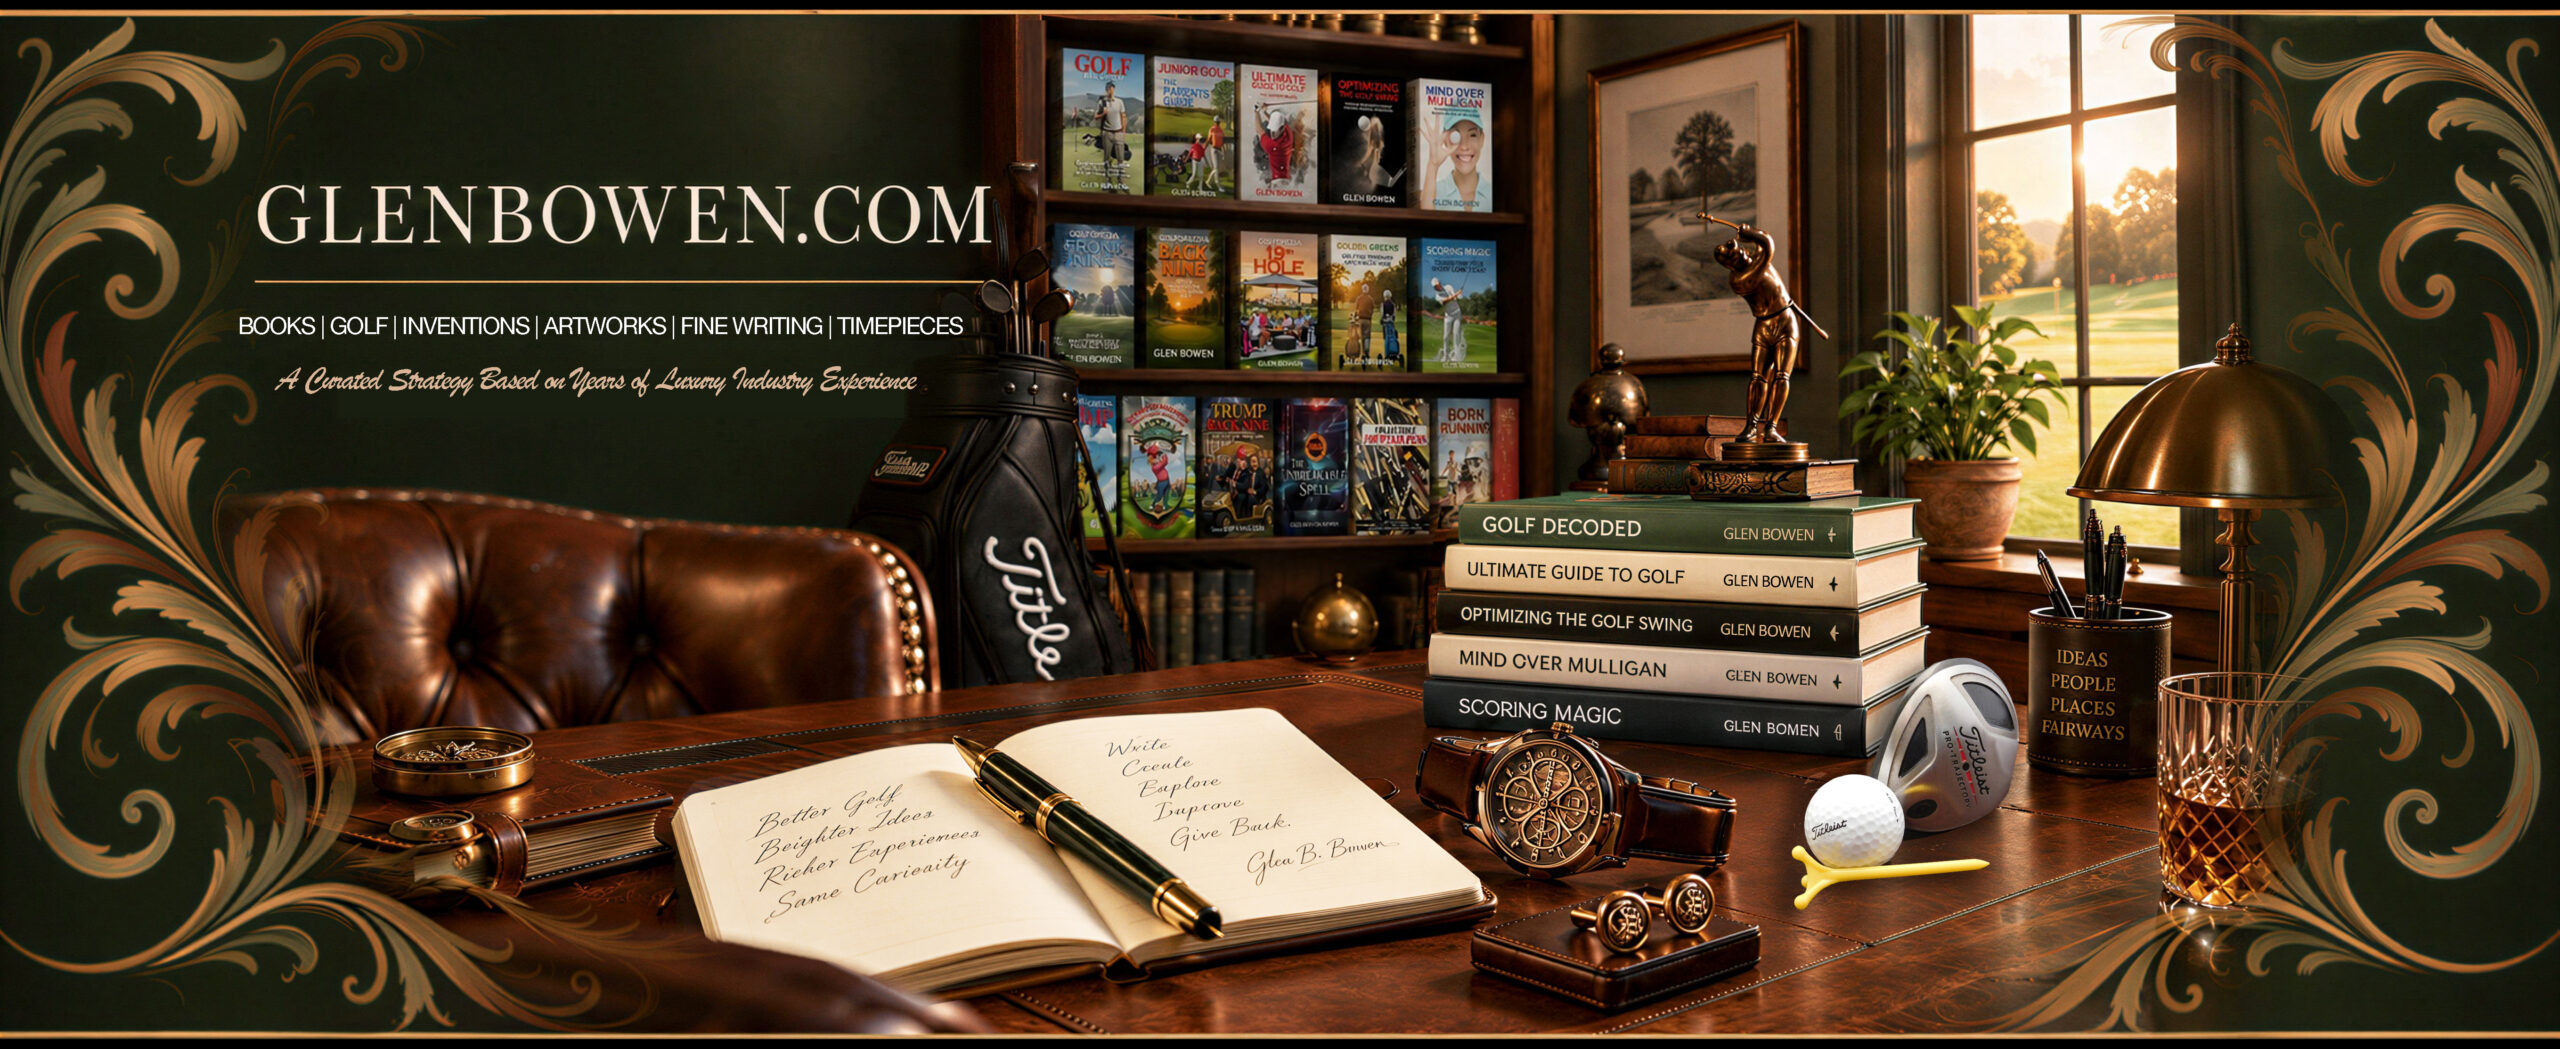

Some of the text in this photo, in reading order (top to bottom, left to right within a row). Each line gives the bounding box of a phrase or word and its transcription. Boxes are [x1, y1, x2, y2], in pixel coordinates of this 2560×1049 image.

[1075, 54, 1132, 76] GOLF
[1158, 63, 1230, 79] JUNIOR GOLF
[1251, 72, 1306, 86] ULTIMATE
[1426, 85, 1484, 98] MIND OVER
[1428, 95, 1482, 109] MULLIGAN
[1343, 193, 1365, 203] GLEN
[1159, 243, 1208, 262] BACK
[1426, 246, 1463, 257] SCORING
[1161, 261, 1207, 277] NINE
[1254, 259, 1304, 276] HOLE
[1154, 348, 1214, 359] GLEN BOWEN
[1211, 403, 1267, 419] TRUMP
[1447, 408, 1484, 421] BORN
[1299, 482, 1331, 497] SPELL
[1482, 516, 1814, 542] GOLF DECODED GLEN BOWEN
[1467, 562, 1814, 590] ULTIMATE GUIDE TO GOLF GLEN BOWEN
[1460, 606, 1811, 639] OPTIMIZING THE GOLF SWING GLEN BOWEN
[2057, 649, 2108, 668] IDEAS
[1459, 651, 1817, 687] MIND OVER MULLIGAN GLEN BOWEN
[2051, 672, 2116, 692] PEOPLE
[1458, 698, 1548, 720] SCORING
[1554, 702, 1622, 726] MAGIC
[1724, 719, 1761, 734] GLEN
[2051, 697, 2116, 717] PLACES
[2042, 719, 2125, 741] FAIRWAYS
[1959, 726, 1990, 795] Titleist
[754, 805, 832, 838] Better
[1811, 819, 1849, 840] Titleist
[1170, 826, 1222, 852] Give
